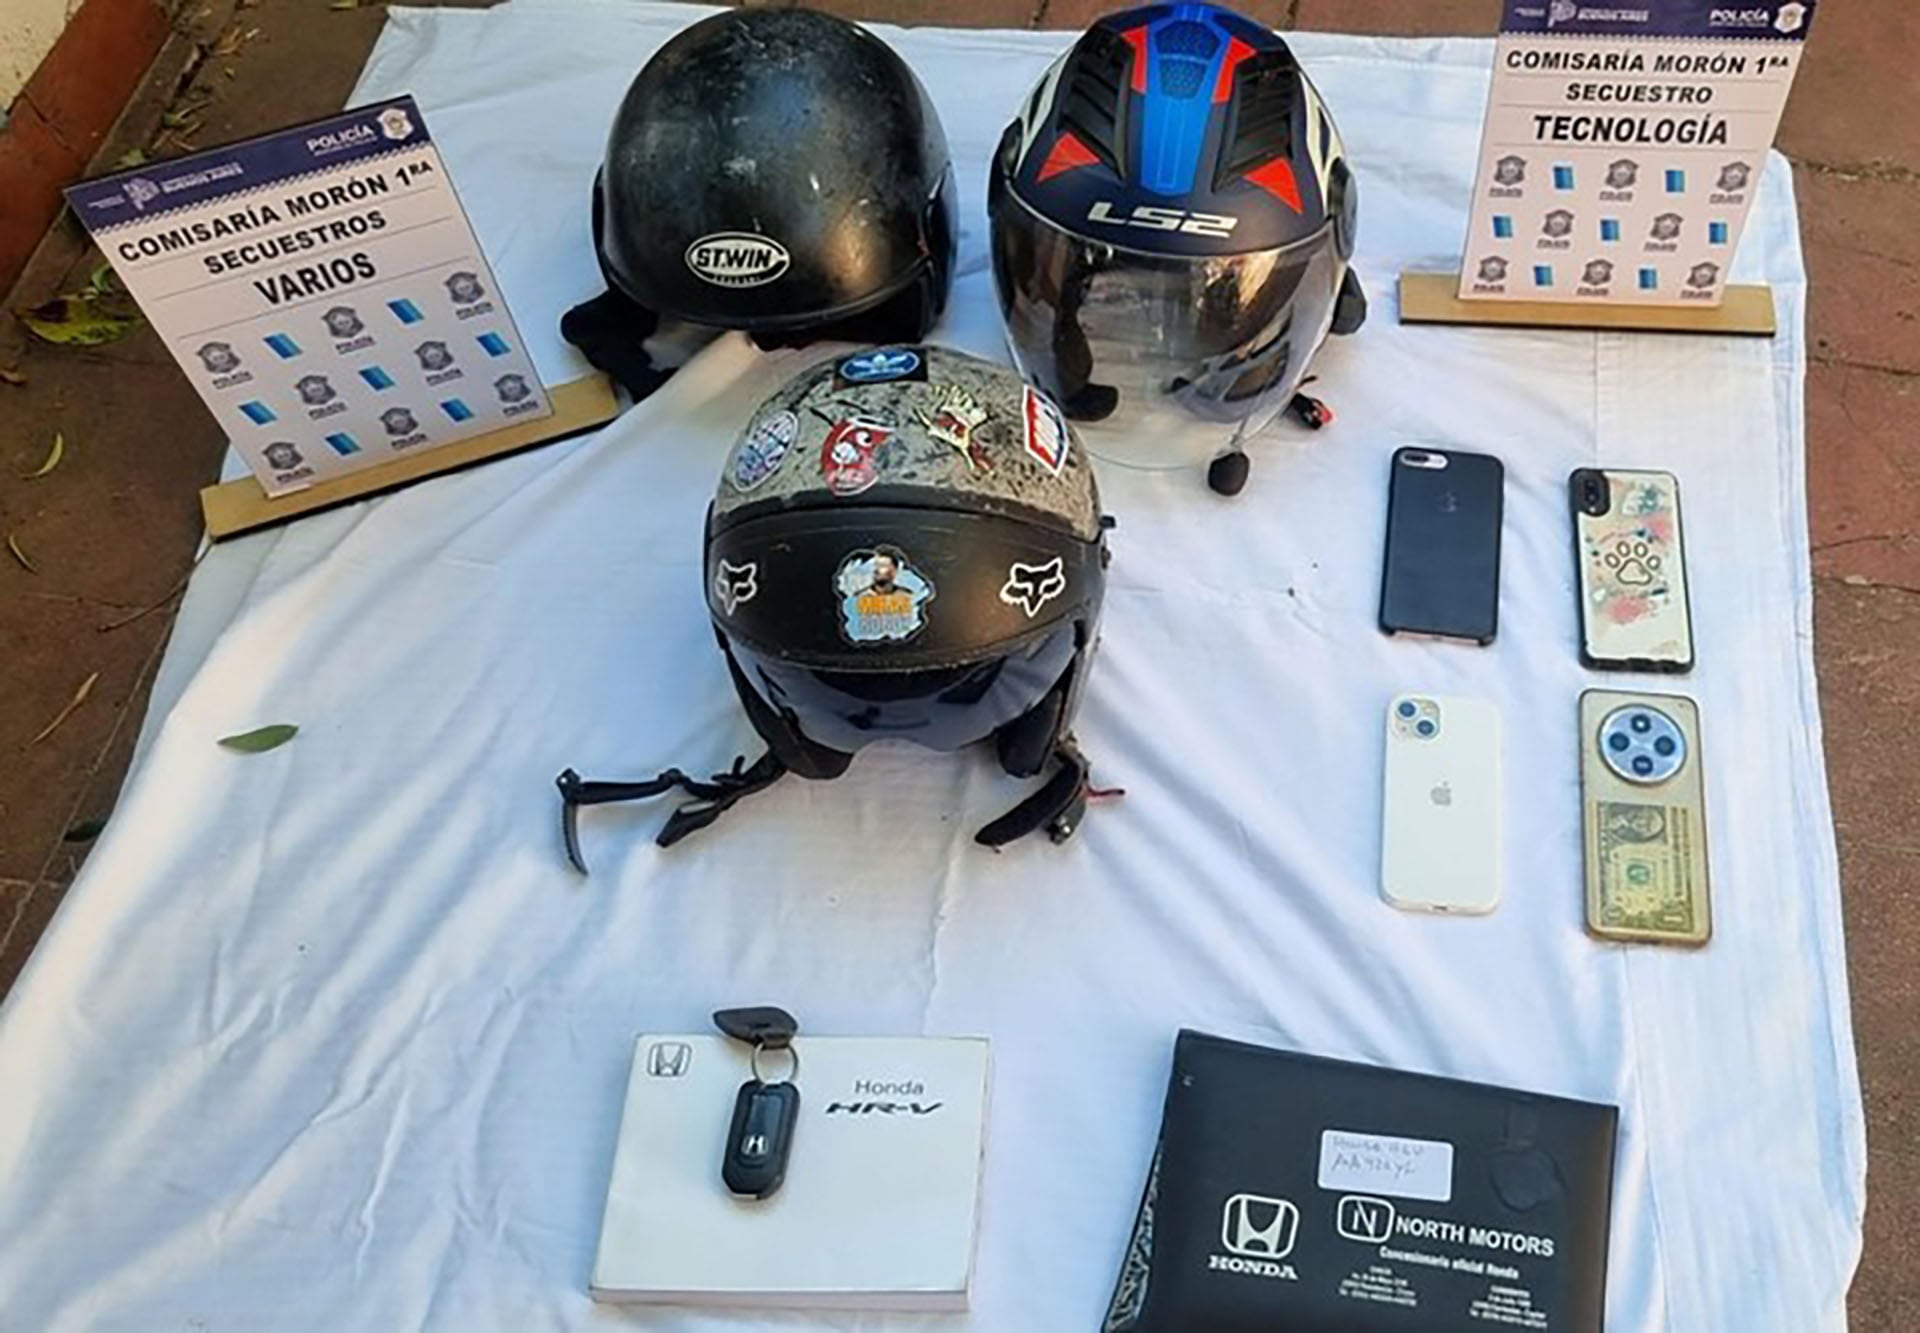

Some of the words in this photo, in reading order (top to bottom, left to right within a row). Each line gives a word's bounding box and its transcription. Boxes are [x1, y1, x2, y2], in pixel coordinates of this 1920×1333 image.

[1507, 50, 1645, 72] COMISARÍA
[1654, 53, 1746, 73] MORÓN
[1566, 83, 1713, 104] SECUESTRO
[306, 124, 374, 151] POLICÍA
[1534, 114, 1727, 144] TECNOLOGÍA
[118, 204, 281, 261] COMISARÍA
[288, 175, 388, 218] MORÓN
[395, 160, 433, 188] 1RA
[1087, 201, 1238, 239] LS2
[203, 210, 387, 274] SECUESTROS
[697, 247, 771, 268] ST.WIN
[254, 252, 376, 305] VARIOS
[854, 1080, 925, 1097] Honda
[825, 1102, 943, 1115] HR-V
[1396, 1216, 1464, 1244] NORTH
[1469, 1227, 1554, 1257] MOTORS
[1208, 1255, 1298, 1280] HONDA
